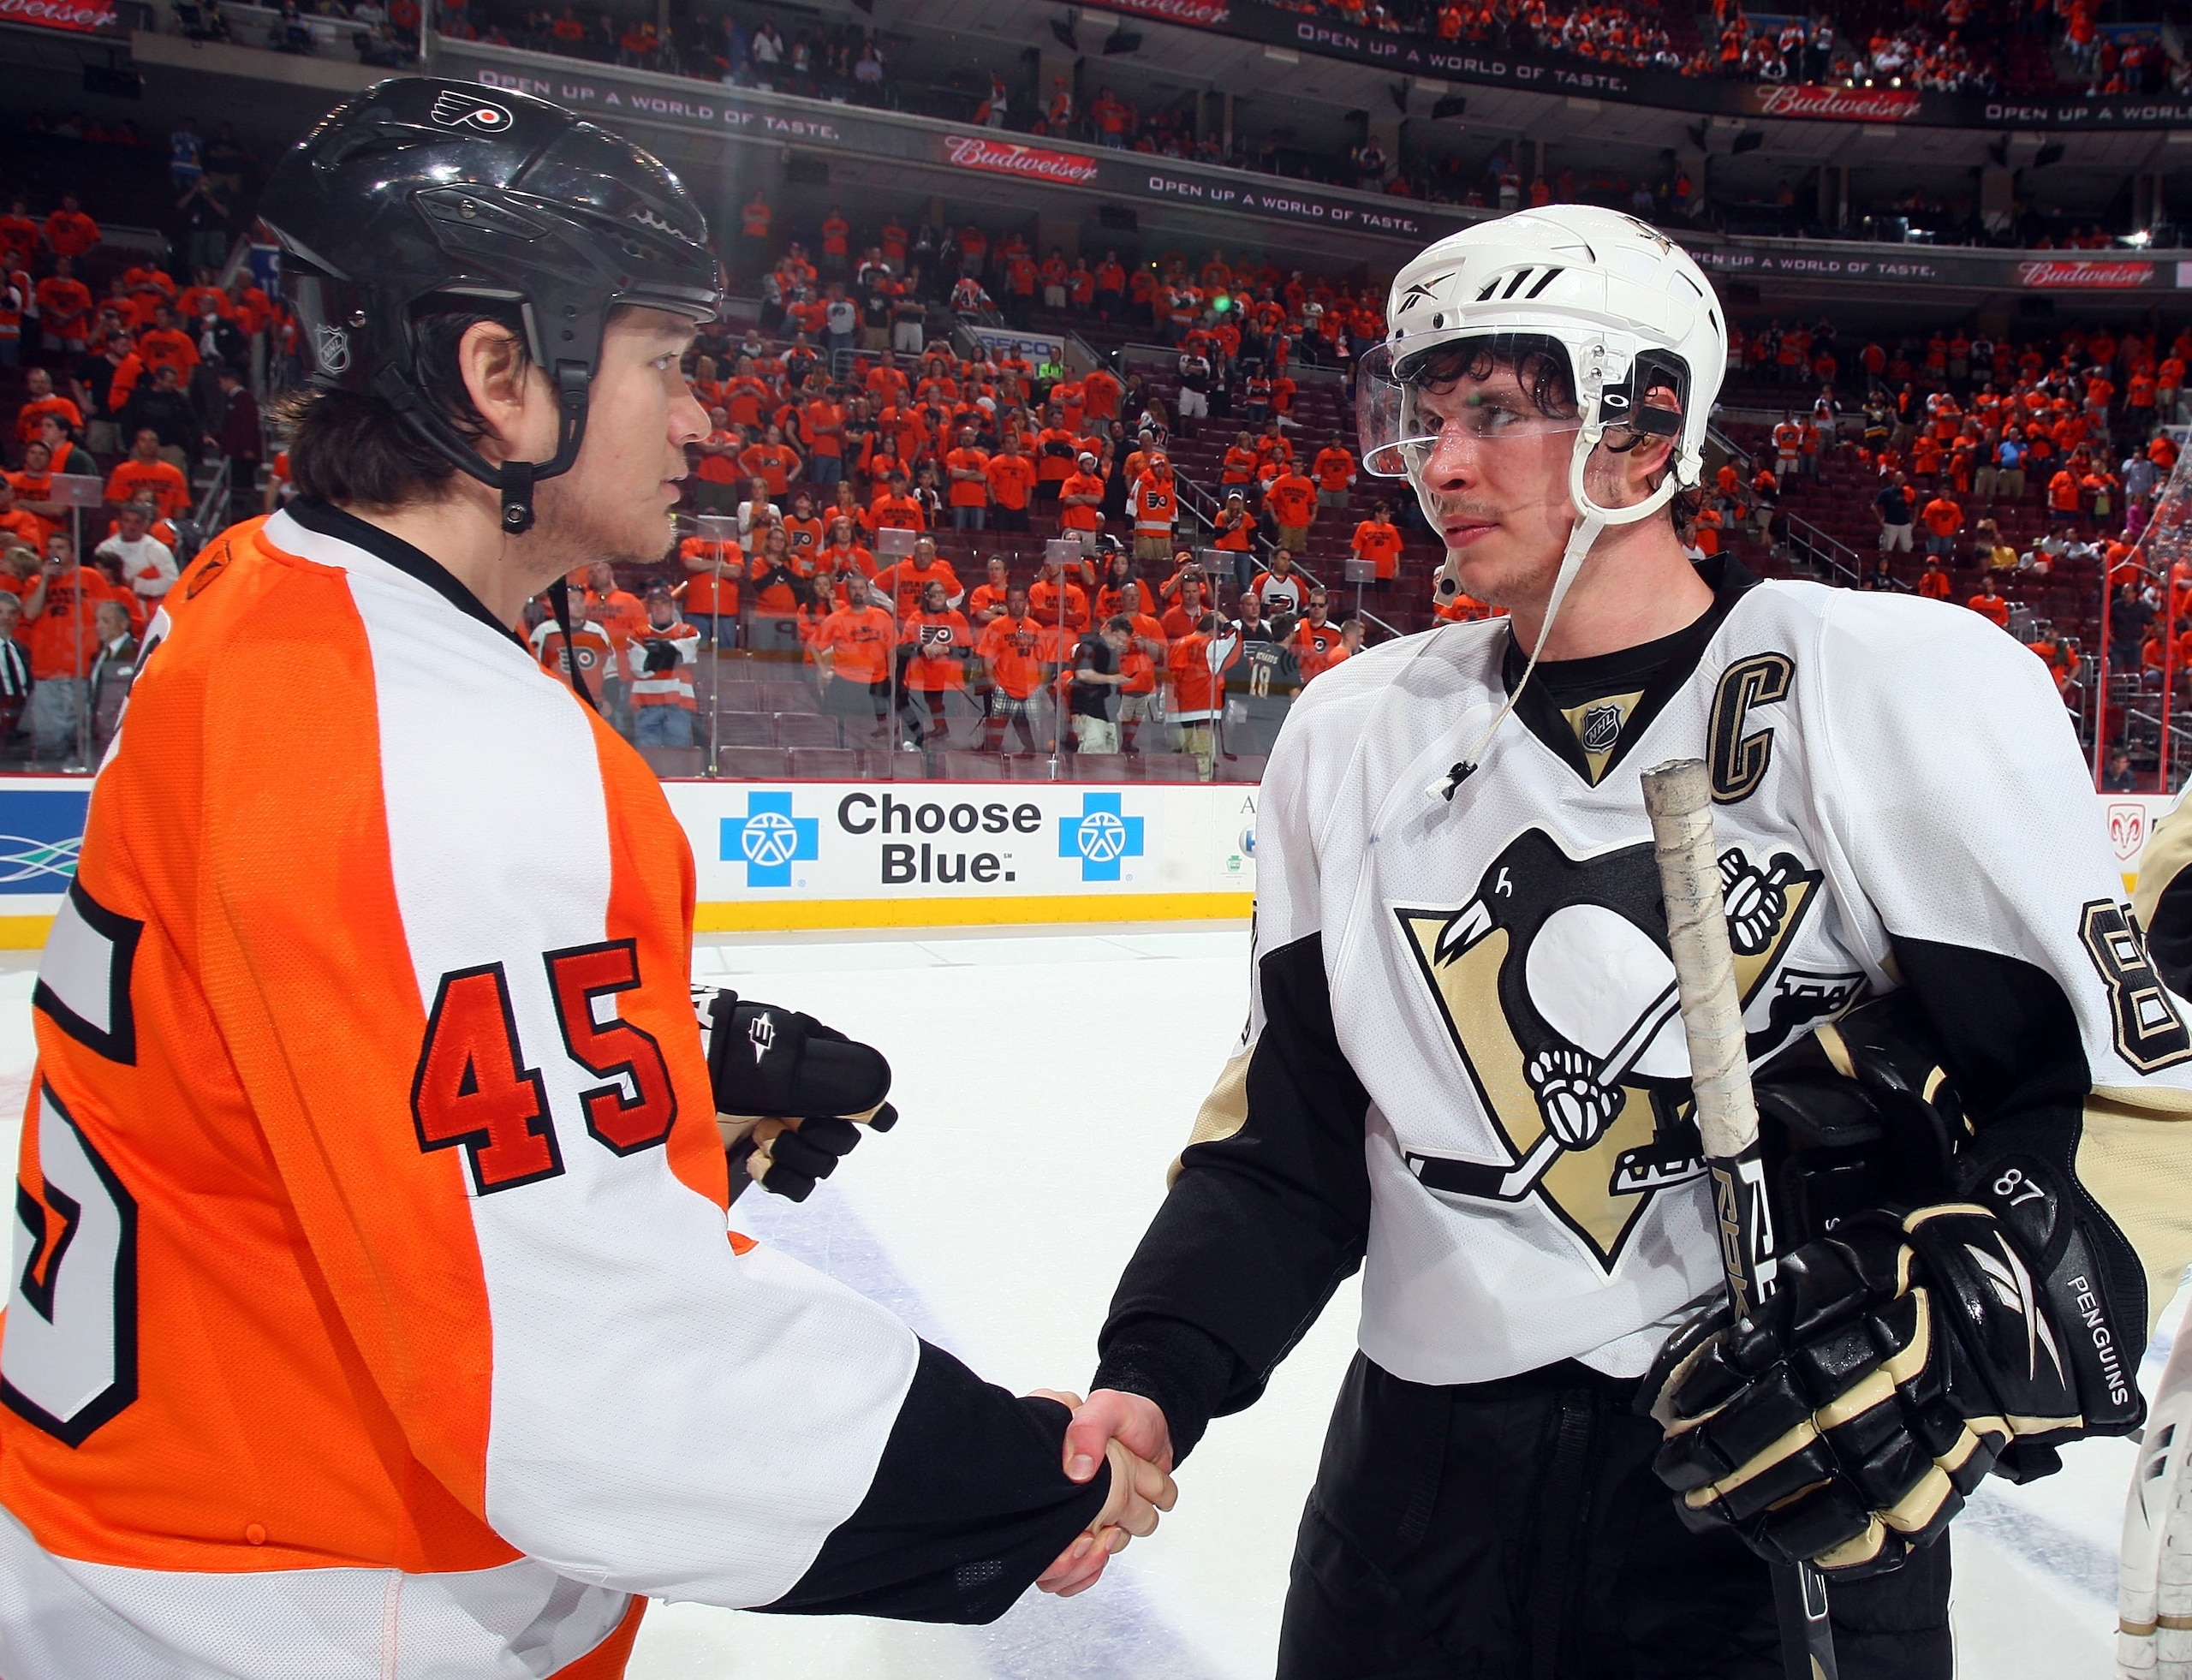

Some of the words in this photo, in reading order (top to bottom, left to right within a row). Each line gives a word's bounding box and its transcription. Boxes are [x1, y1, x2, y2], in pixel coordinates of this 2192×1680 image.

[1297, 23, 1360, 50] OPEN
[1370, 41, 1397, 56] UP
[1407, 49, 1420, 62] A
[1429, 53, 1507, 76] WORLD
[1516, 64, 1545, 79] OF
[563, 84, 595, 101] UP
[605, 92, 622, 107] A
[631, 96, 715, 121] WORLD
[724, 109, 751, 126] OF
[765, 115, 840, 140] TASTE.
[1756, 85, 1921, 118] Budweiser
[1986, 104, 2049, 121] OPEN
[2058, 107, 2088, 122] UP
[2098, 107, 2112, 120] A
[2124, 105, 2192, 121] WORL
[944, 135, 1099, 181] Budweiser
[1149, 176, 1202, 197] OPEN
[1210, 188, 1235, 201] UP
[1242, 194, 1255, 206] A
[1262, 197, 1325, 217] WORLD
[1331, 207, 1356, 220] OF
[1361, 212, 1419, 233] TASTE.
[1687, 250, 1724, 265] PEN
[1731, 255, 1755, 266] UP
[1761, 257, 1773, 268] A
[1779, 259, 1841, 272] WORLD
[1847, 261, 1869, 273] OF
[1877, 262, 1937, 277] TASTE.
[2017, 260, 2156, 286] Budweiser
[980, 335, 1051, 355] GECO
[1589, 714, 1614, 744] NHL
[1706, 652, 1796, 805] C
[837, 792, 1041, 835] Choose
[881, 843, 1016, 884] Blue.
[2078, 897, 2192, 1076] 8
[410, 938, 678, 1197] 45
[1992, 1168, 2046, 1206] 87
[2067, 1274, 2129, 1406] PENGUINS
